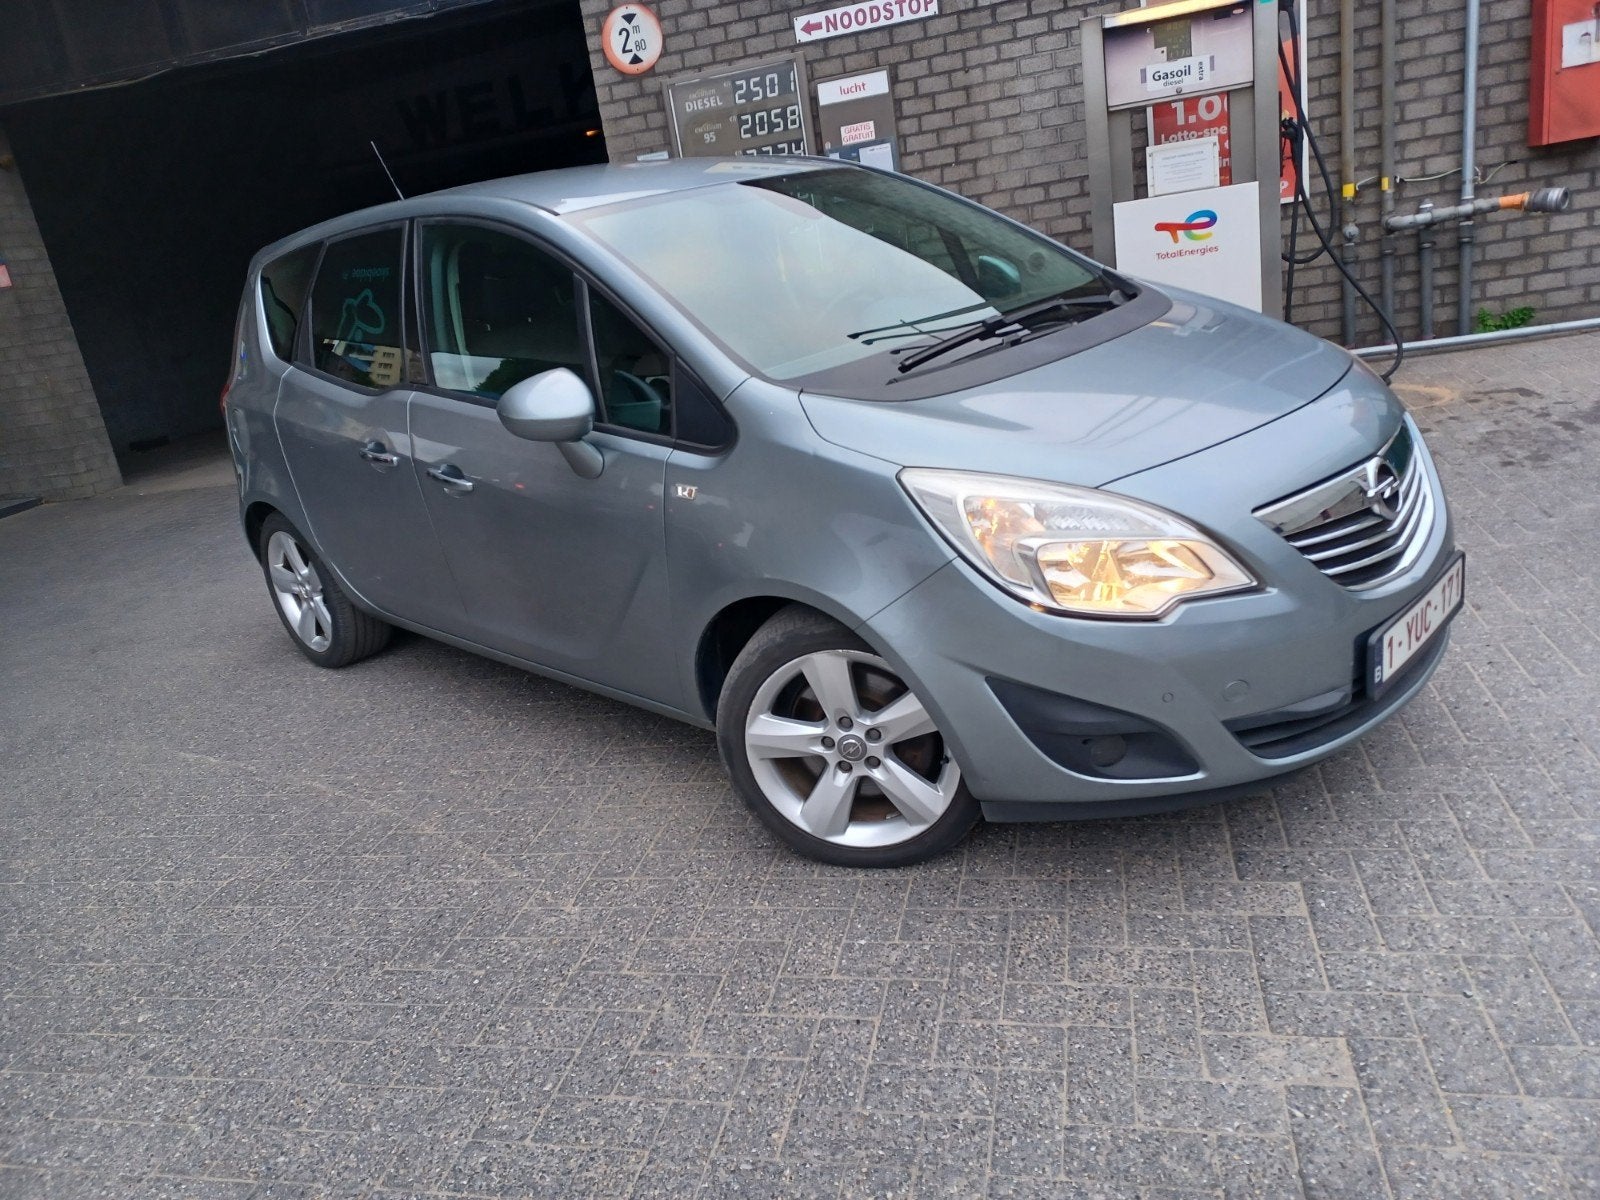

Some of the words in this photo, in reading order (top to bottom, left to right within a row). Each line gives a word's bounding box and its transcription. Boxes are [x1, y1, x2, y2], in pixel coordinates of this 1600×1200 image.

[825, 0, 934, 32] NOODSTOP
[632, 24, 641, 35] m
[618, 27, 633, 54] 2
[634, 38, 647, 51] 80
[1152, 64, 1191, 81] Gasoil
[735, 70, 795, 104] 2501
[839, 82, 866, 96] lucht
[1162, 77, 1184, 87] diesel
[685, 95, 723, 112] DIESEL
[1171, 94, 1228, 126] 1.0
[740, 105, 800, 139] 2058
[844, 122, 871, 135] GRATIS
[703, 131, 717, 144] 95
[842, 130, 874, 144] GRATUIT
[1156, 244, 1220, 261] TotalEnergies
[1387, 566, 1461, 670] 1-YUC-171
